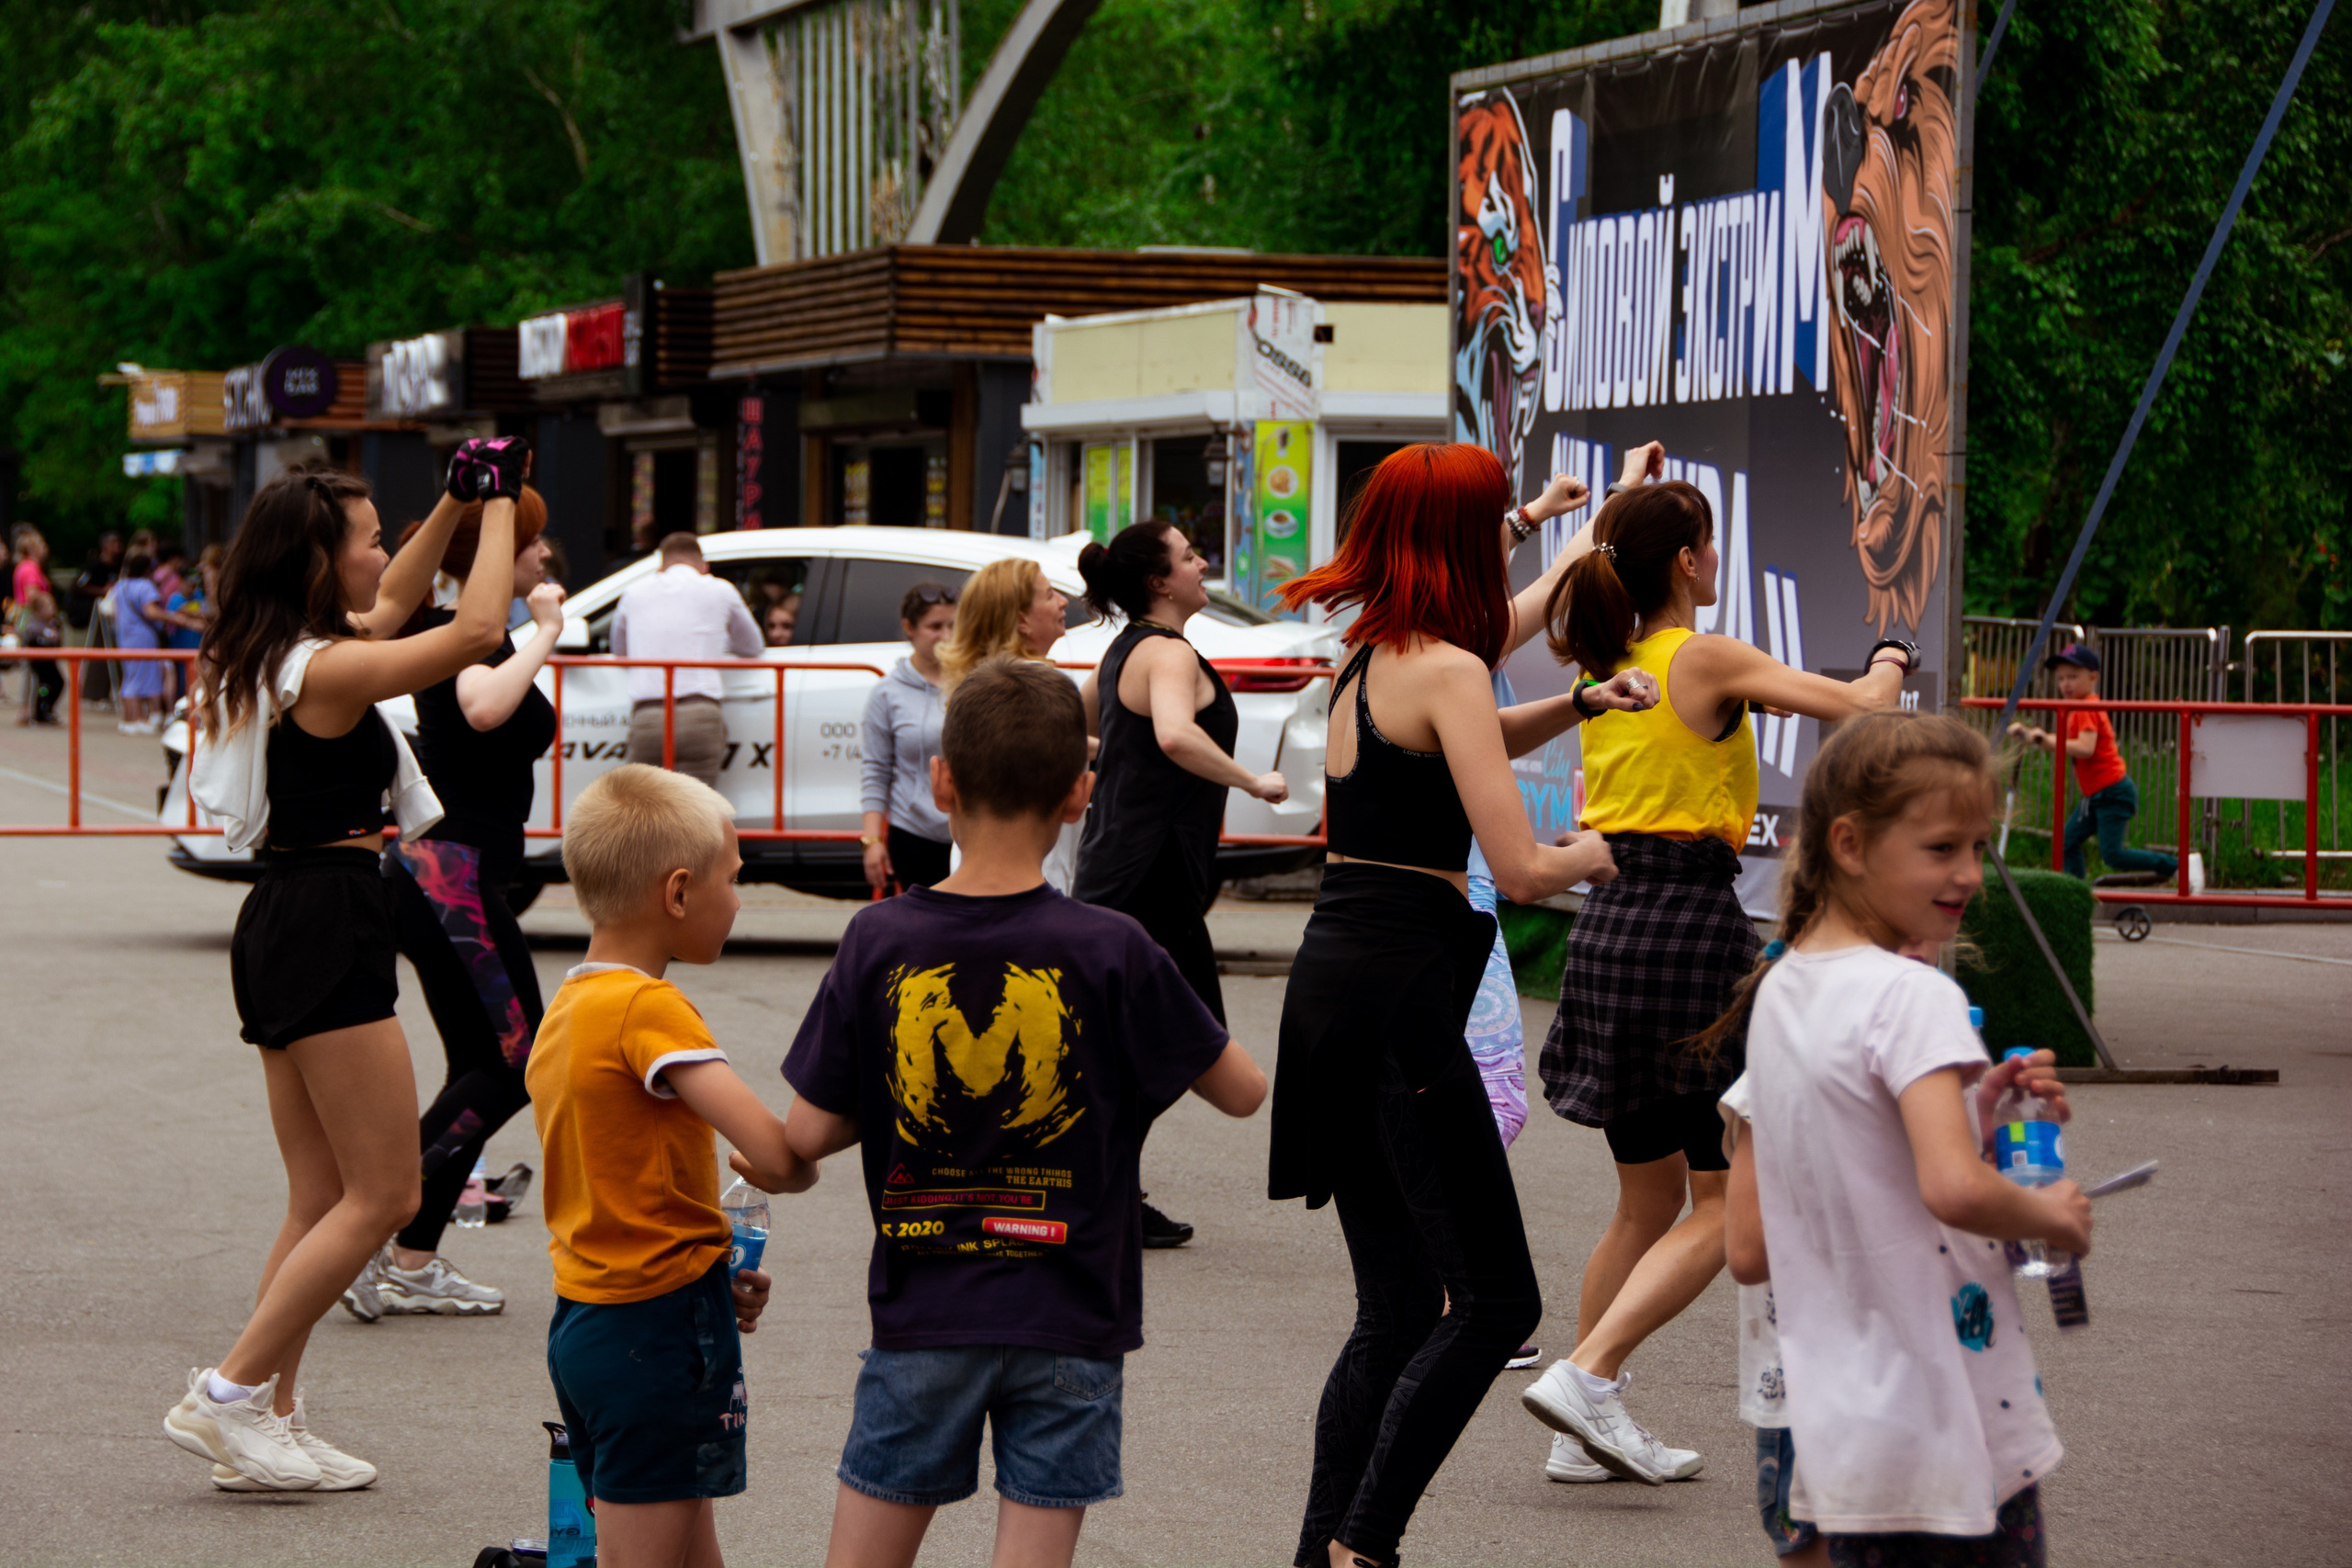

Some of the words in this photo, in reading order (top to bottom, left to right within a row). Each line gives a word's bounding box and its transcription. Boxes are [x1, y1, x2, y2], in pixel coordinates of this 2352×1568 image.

[1675, 51, 1832, 404] ЭКСТРИМ
[1371, 728, 1390, 746] SECRET
[555, 740, 628, 760] AVA
[1403, 749, 1421, 757] LOVE
[932, 1168, 965, 1177] CHOOSE
[1006, 1167, 1039, 1176] WRONG
[1006, 1175, 1027, 1184] THE
[884, 1196, 908, 1205] JUST
[896, 1221, 945, 1237] 2020
[957, 1241, 979, 1252] INK
